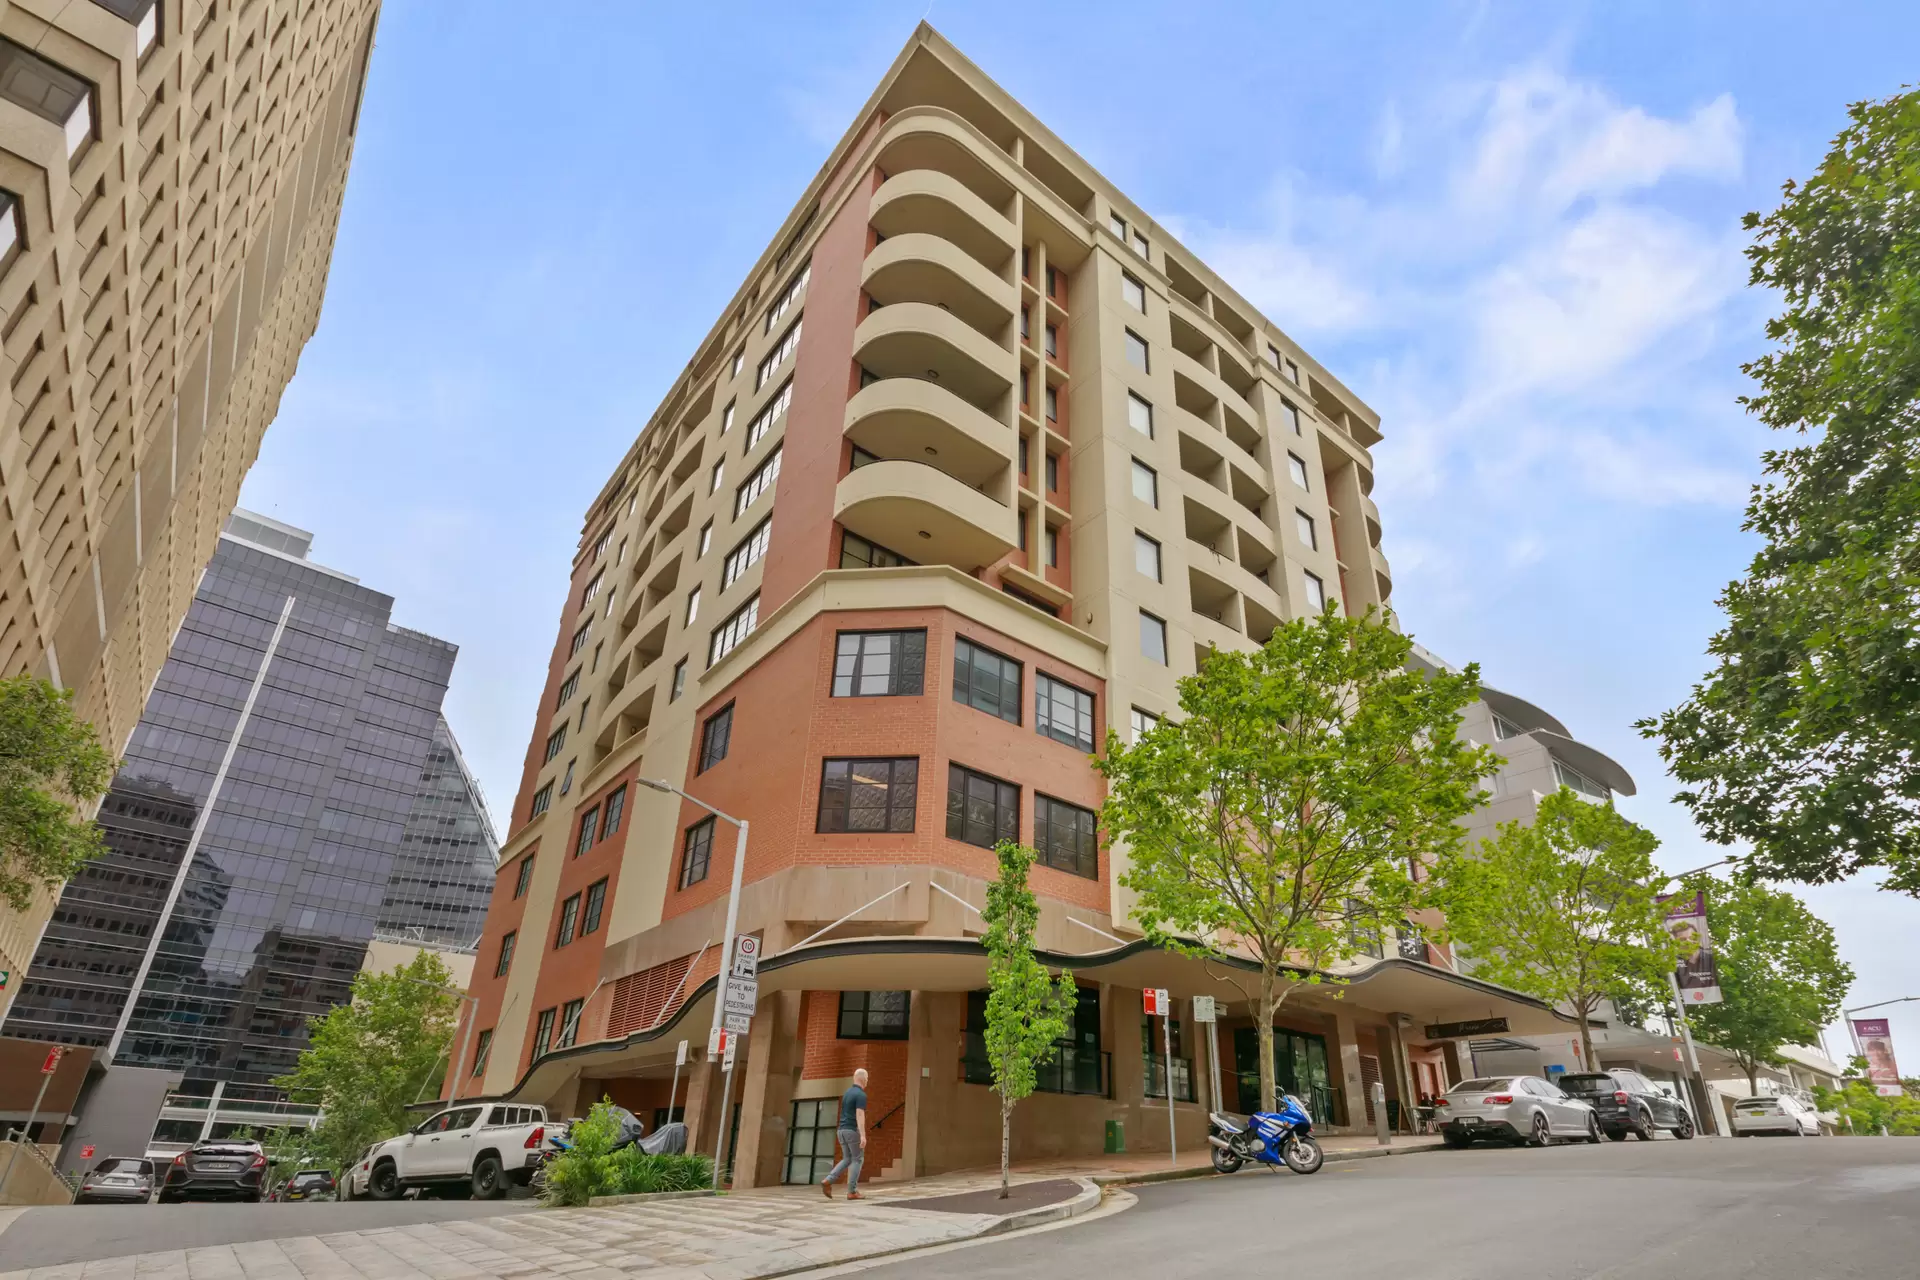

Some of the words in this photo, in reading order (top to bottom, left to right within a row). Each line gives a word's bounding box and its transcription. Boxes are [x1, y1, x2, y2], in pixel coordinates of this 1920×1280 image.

[744, 942, 752, 950] 10
[728, 982, 741, 991] GIVE
[743, 984, 756, 993] WAY
[737, 992, 745, 1000] TO
[725, 999, 754, 1011] PEDESTRIANS
